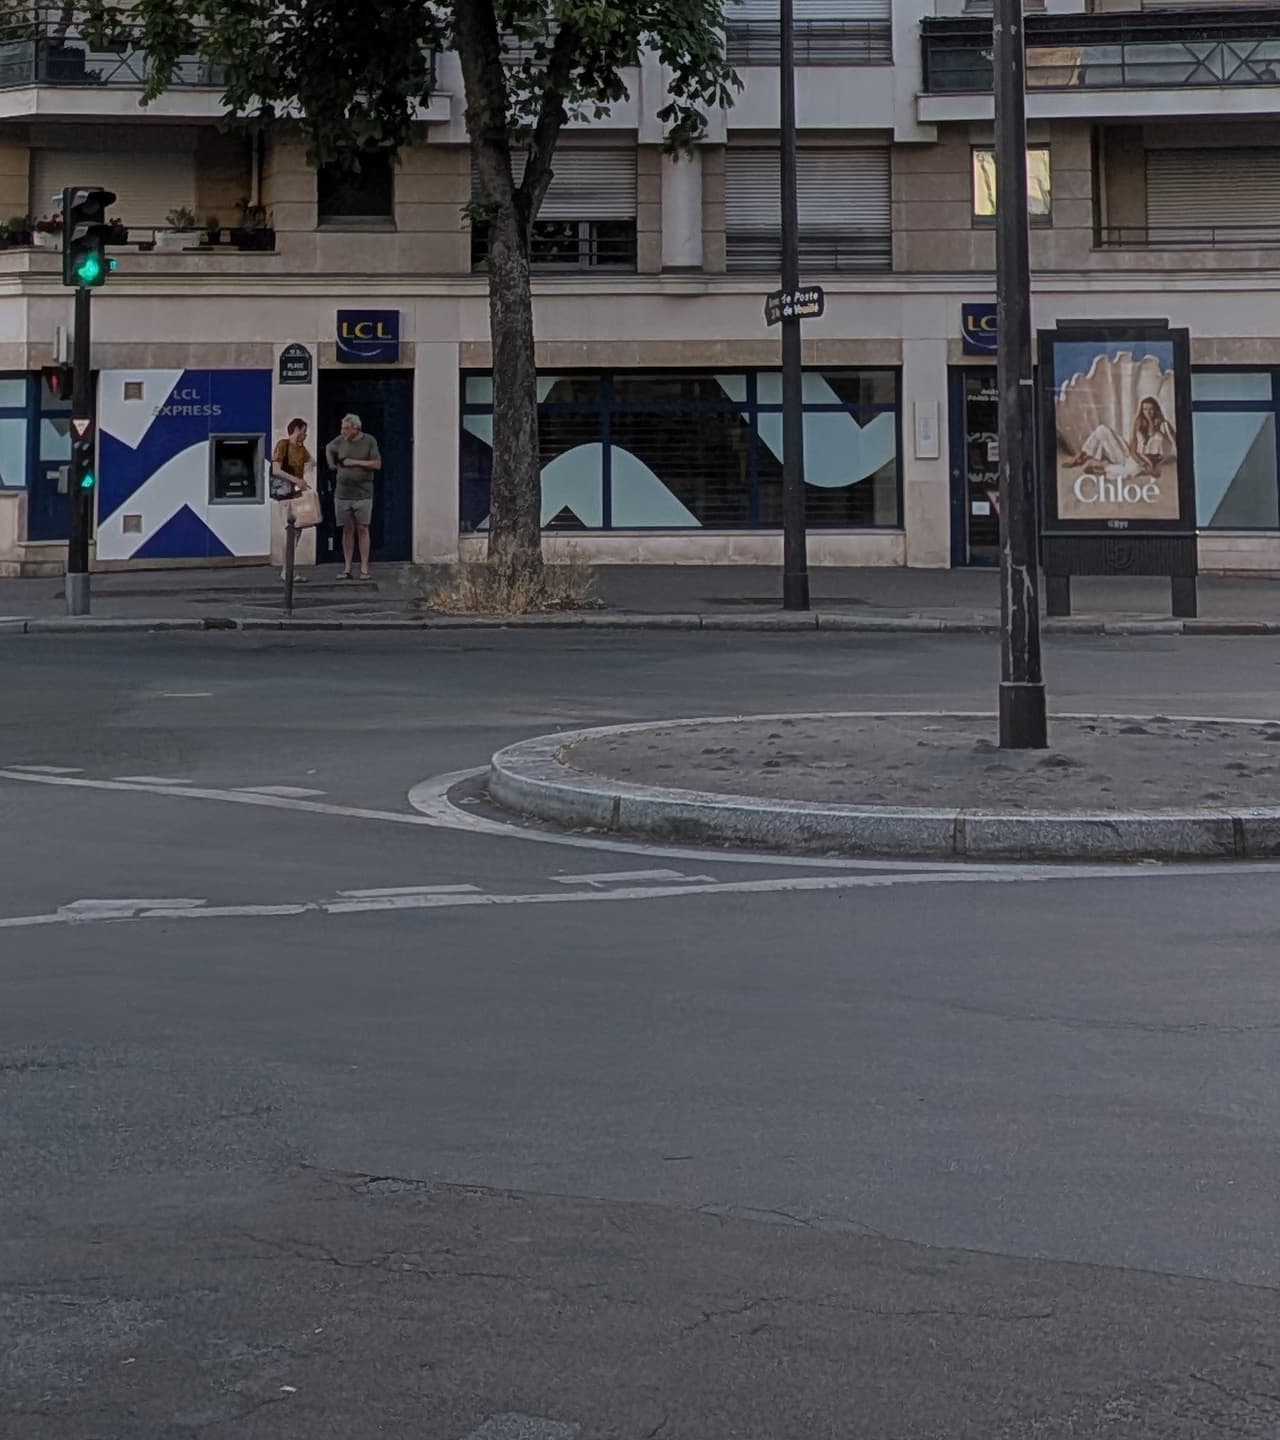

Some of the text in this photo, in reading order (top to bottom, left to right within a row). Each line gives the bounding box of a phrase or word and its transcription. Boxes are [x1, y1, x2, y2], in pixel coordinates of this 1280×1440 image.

[794, 291, 819, 302] Poste
[342, 322, 392, 338] LCL
[967, 315, 999, 331] LC
[173, 388, 200, 400] LCL
[152, 405, 222, 416] EXPRESS
[1074, 473, 1160, 504] Chloé
